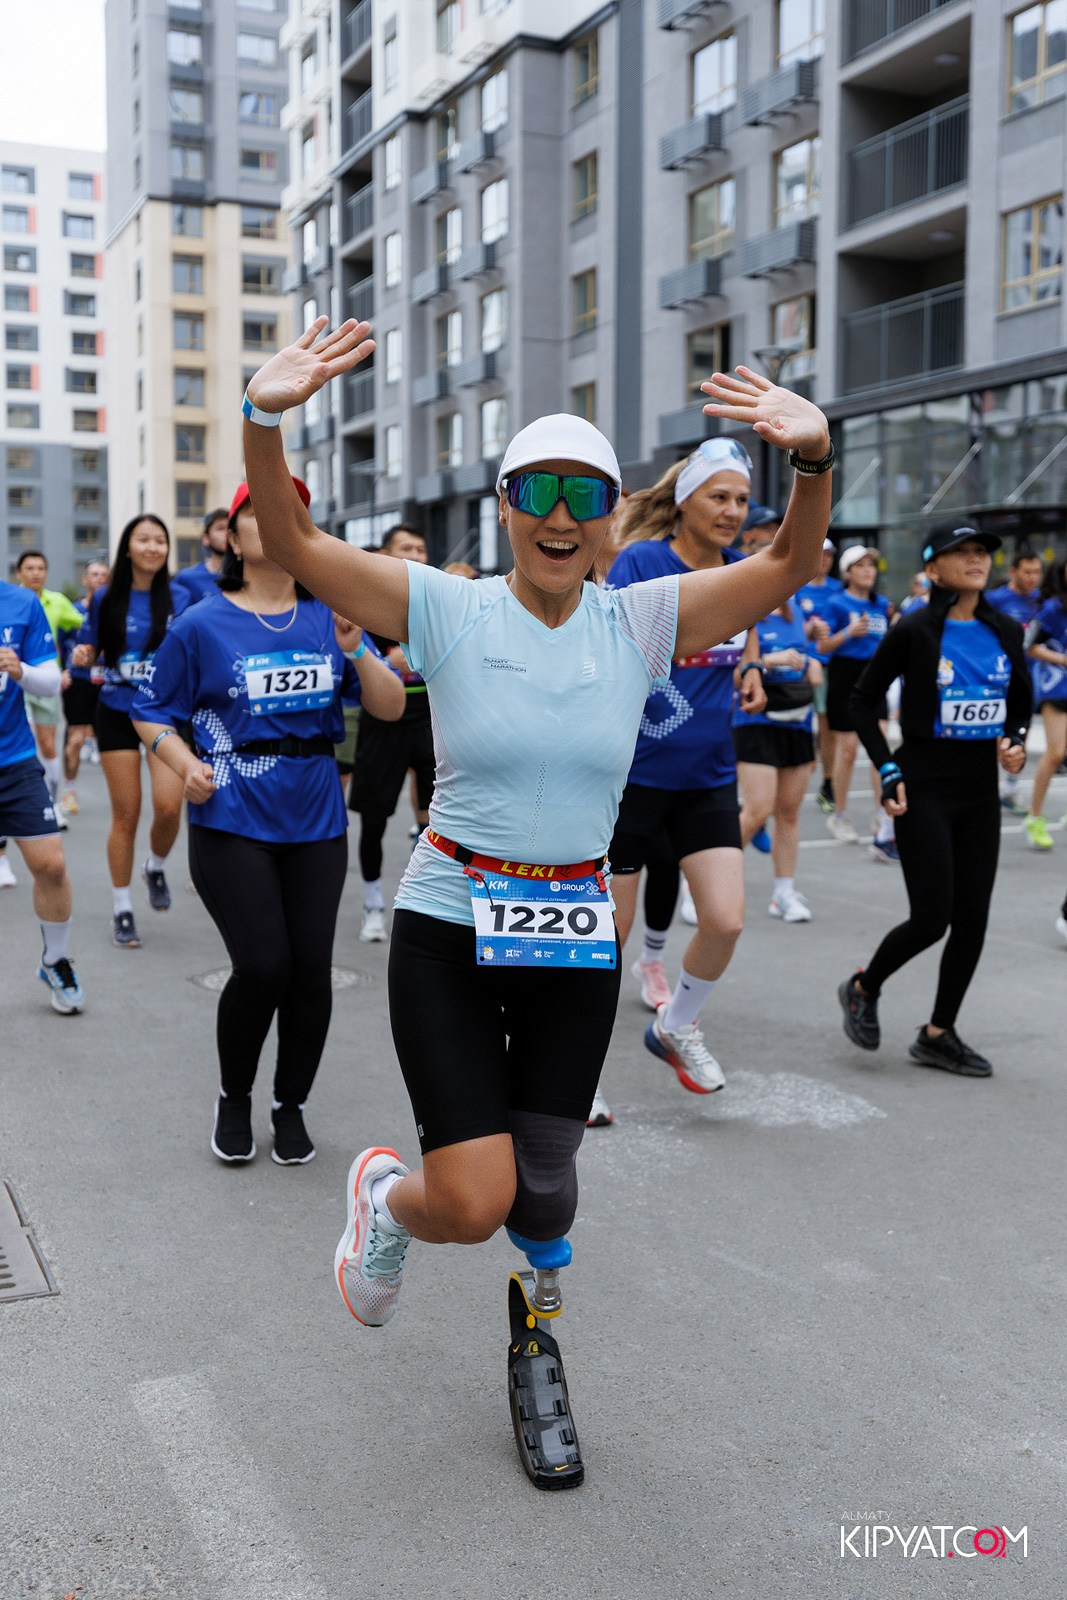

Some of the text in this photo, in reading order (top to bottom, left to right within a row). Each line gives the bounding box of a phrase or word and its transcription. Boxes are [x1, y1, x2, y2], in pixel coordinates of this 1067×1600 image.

[490, 664, 527, 672] MARATHON
[263, 669, 318, 694] 1321
[953, 704, 1000, 721] 1667
[501, 862, 556, 877] LEKI
[488, 880, 508, 890] KM
[562, 883, 586, 892] GROUP
[490, 905, 598, 936] 1220
